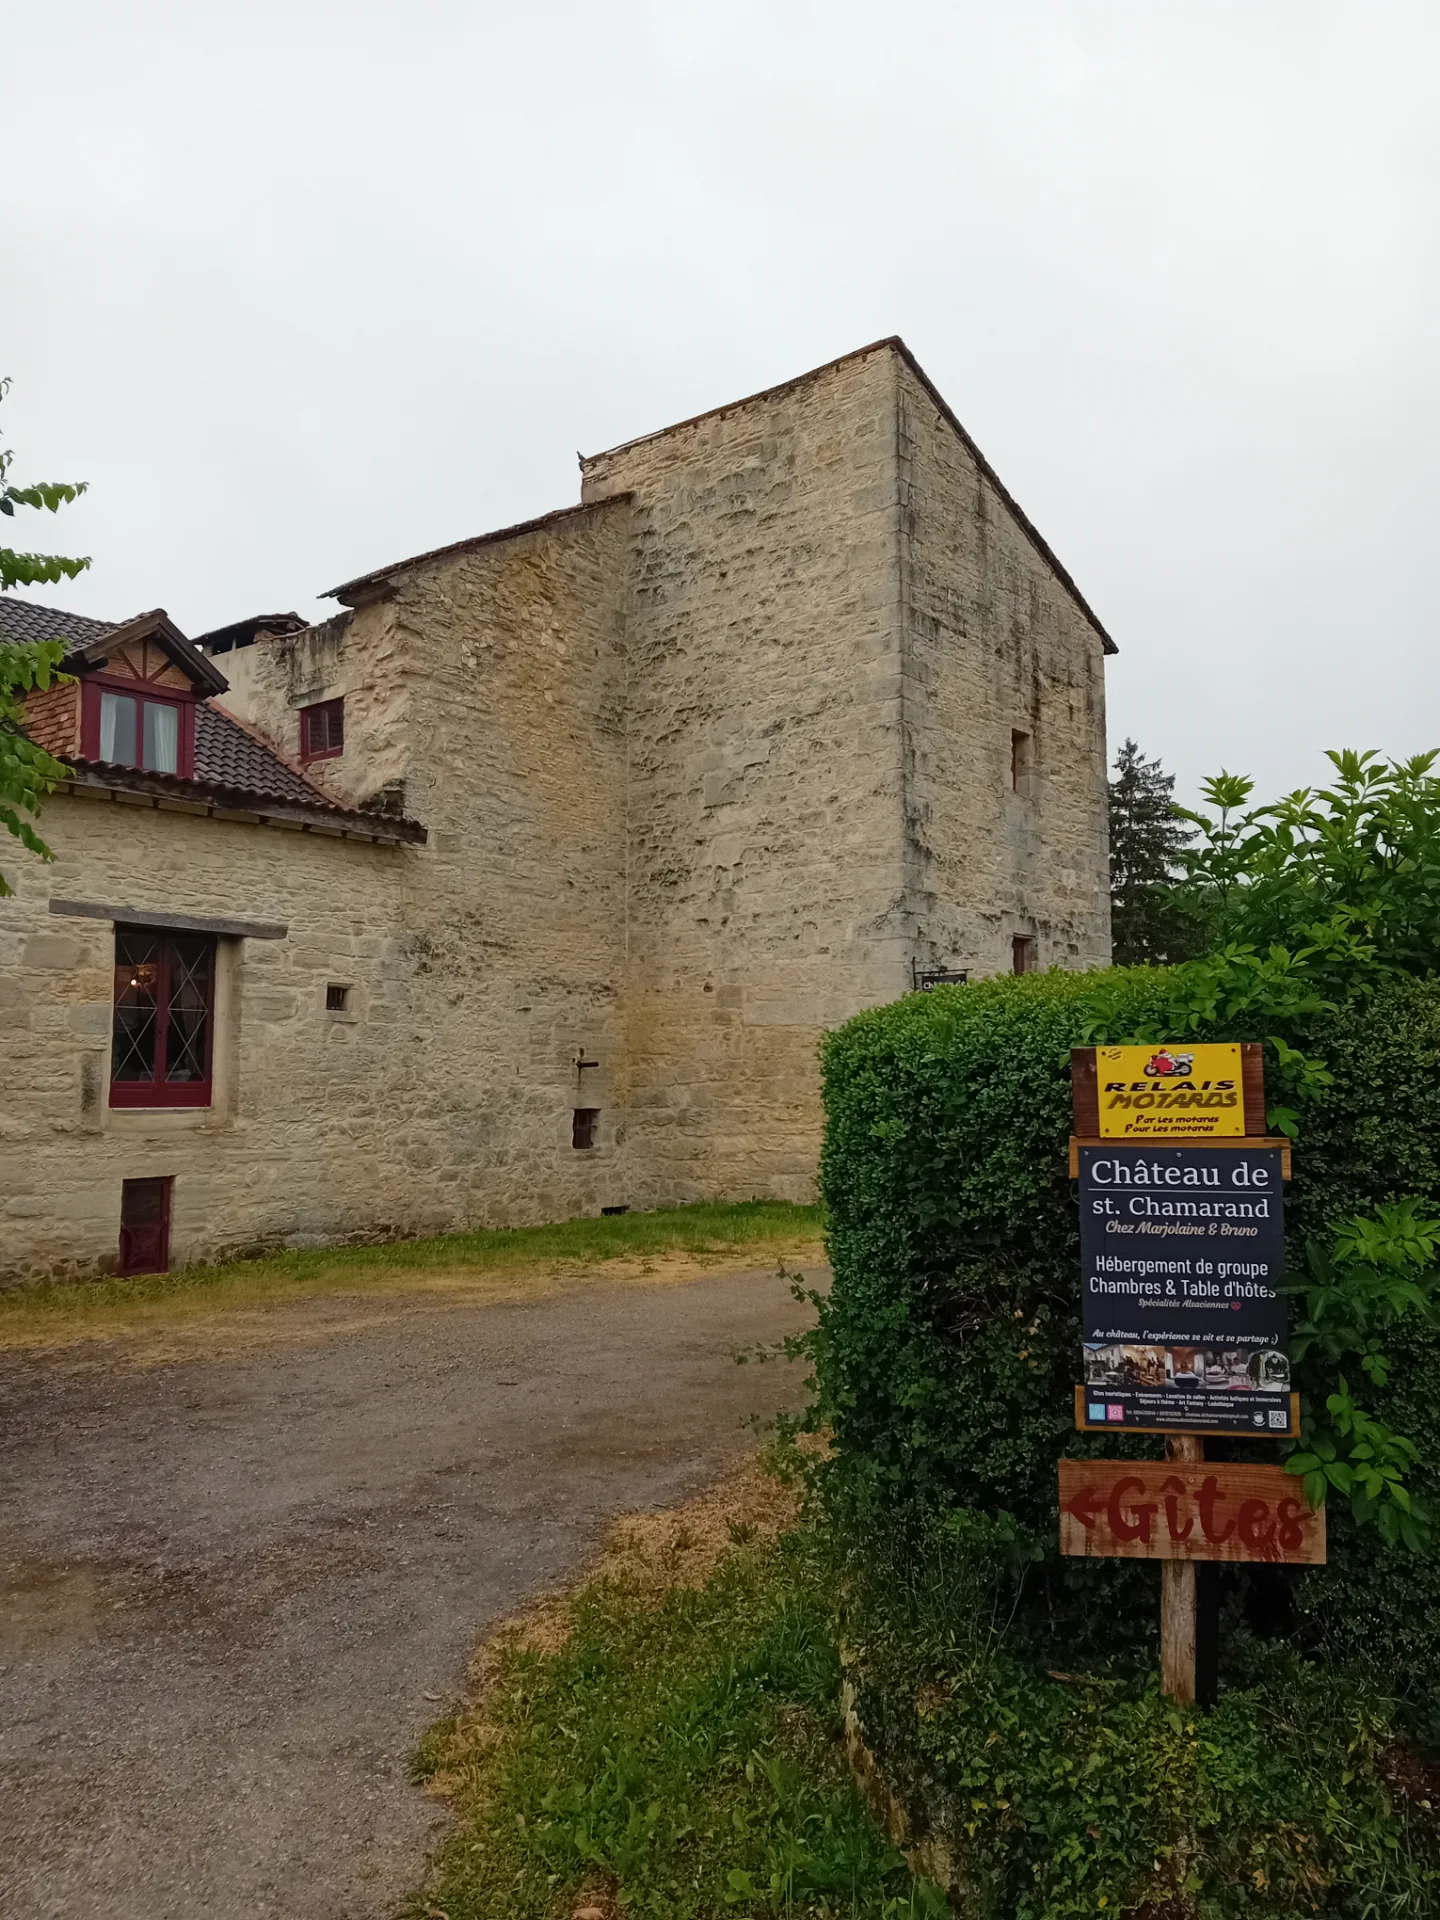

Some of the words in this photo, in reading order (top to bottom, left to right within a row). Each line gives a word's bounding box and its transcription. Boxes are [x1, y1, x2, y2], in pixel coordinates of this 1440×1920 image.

[1104, 1081, 1235, 1092] RELAIS
[1107, 1092, 1238, 1109] MOTARDS
[1135, 1114, 1156, 1125] Par
[1175, 1116, 1220, 1124] motards
[1124, 1123, 1151, 1134] Pour
[1170, 1125, 1214, 1133] motards
[1091, 1159, 1221, 1186] Château
[1231, 1161, 1269, 1186] de
[1092, 1197, 1121, 1215] st.
[1128, 1196, 1270, 1218] Chamarand
[1105, 1220, 1135, 1234] Chez
[1135, 1221, 1205, 1238] Marjolaine
[1208, 1222, 1218, 1236] &
[1220, 1223, 1258, 1237] Bruno
[1096, 1255, 1192, 1277] Hébergement
[1195, 1258, 1214, 1275] de
[1217, 1262, 1269, 1280] groupe
[1089, 1276, 1162, 1295] Chambres
[1165, 1279, 1177, 1296] &
[1181, 1279, 1221, 1297] Table
[1224, 1281, 1277, 1299] d'hôtes
[1138, 1297, 1181, 1309] Spécialités
[1181, 1299, 1230, 1309] Alsaciennes
[1091, 1328, 1105, 1338] Au
[1105, 1328, 1141, 1340] château,
[1142, 1329, 1191, 1342] l'expérience
[1191, 1333, 1201, 1341] se
[1202, 1332, 1215, 1342] vit
[1215, 1334, 1225, 1342] et
[1225, 1334, 1236, 1342] se
[1235, 1334, 1270, 1345] partage
[1107, 1475, 1315, 1550] Gîtes
